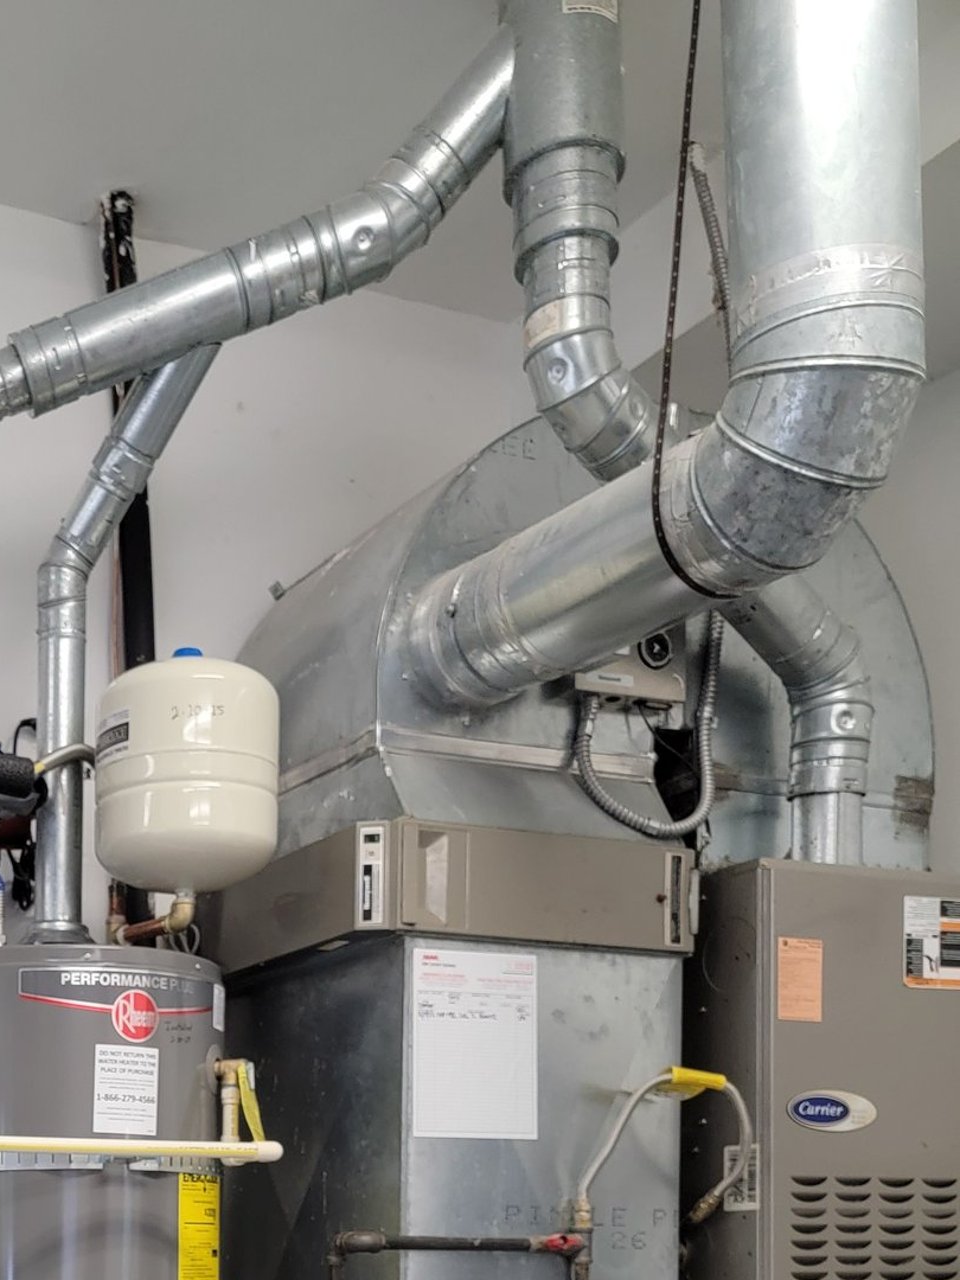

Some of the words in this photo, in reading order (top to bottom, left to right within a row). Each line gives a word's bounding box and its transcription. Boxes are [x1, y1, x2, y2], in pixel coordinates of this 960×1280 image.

[60, 972, 168, 990] PERFORMANCE
[118, 991, 156, 1034] Rheem
[798, 1101, 844, 1117] Carrier
